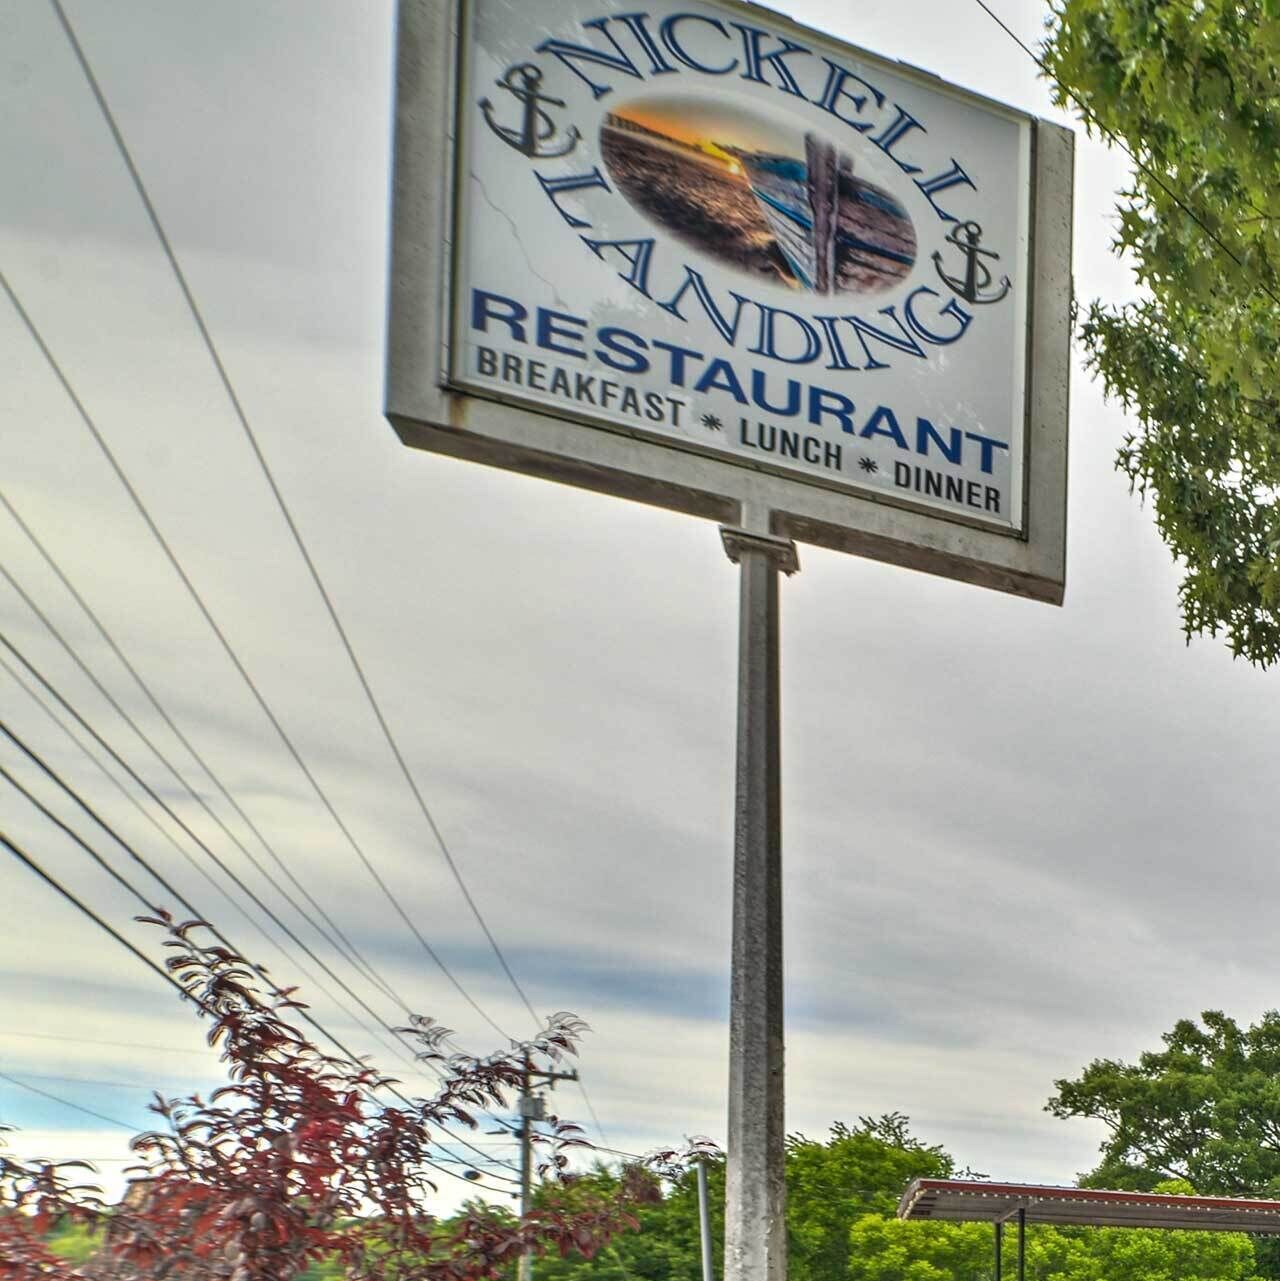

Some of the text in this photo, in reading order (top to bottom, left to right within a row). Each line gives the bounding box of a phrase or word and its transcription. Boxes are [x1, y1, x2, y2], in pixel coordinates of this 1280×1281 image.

[535, 13, 977, 222] NICKELL
[533, 165, 974, 371] LANDING
[471, 287, 1009, 475] RESTAURANT
[477, 346, 1002, 513] BREAKFAST LUNCH DINNER
